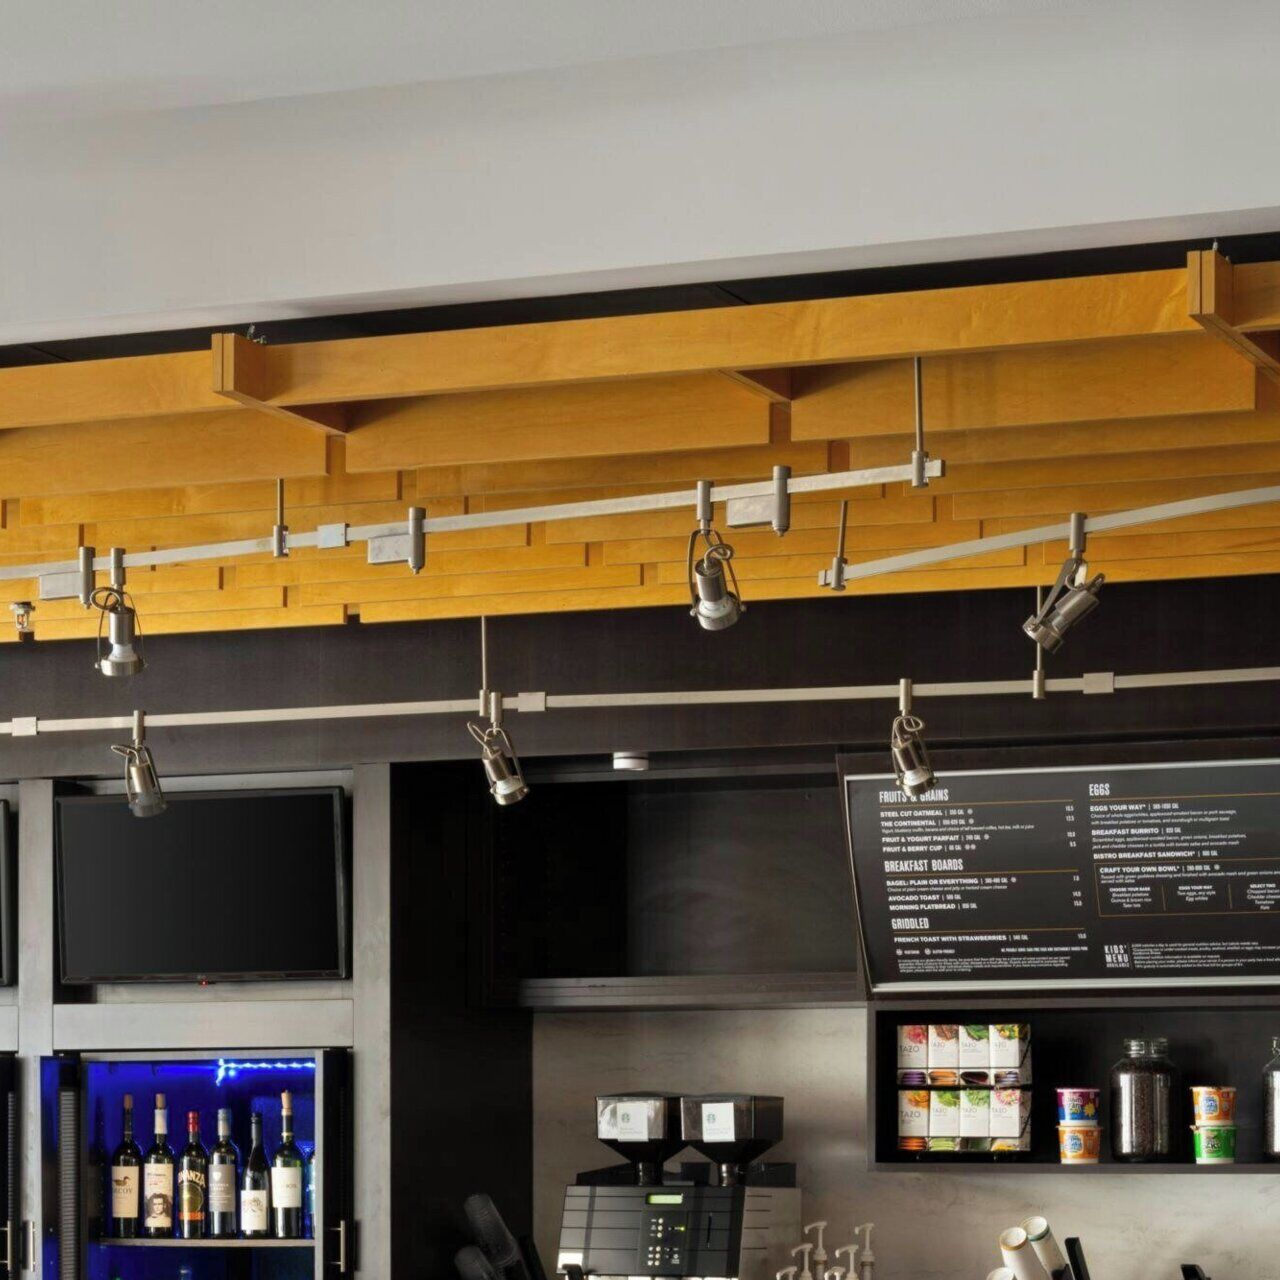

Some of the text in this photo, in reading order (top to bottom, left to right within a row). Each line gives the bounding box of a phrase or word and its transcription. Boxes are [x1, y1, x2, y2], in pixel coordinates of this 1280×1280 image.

[1089, 783, 1110, 796] EGGS
[884, 859, 963, 872] BREAKFAST BOARDS
[891, 918, 929, 929] GRIDDLED
[1106, 954, 1128, 962] MENU
[900, 1110, 921, 1118] TAZO
